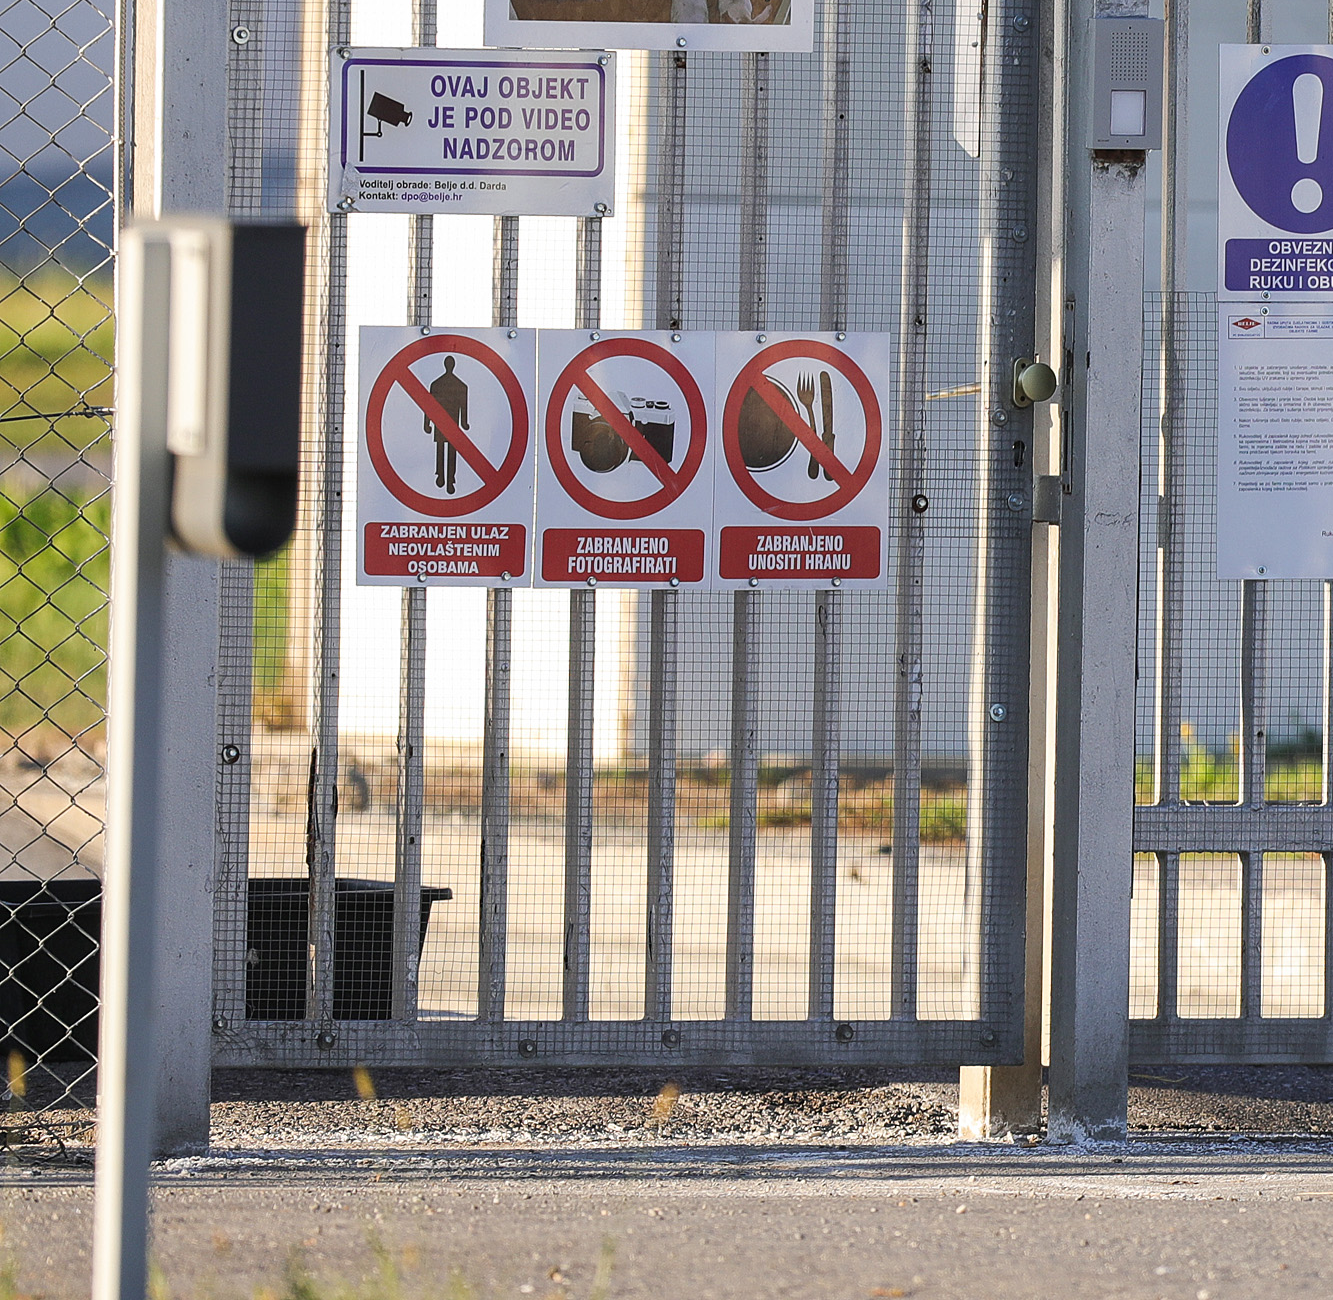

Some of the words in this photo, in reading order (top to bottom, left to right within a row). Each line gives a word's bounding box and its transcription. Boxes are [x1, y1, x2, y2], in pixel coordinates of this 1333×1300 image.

[430, 74, 488, 98] OVAJ
[498, 76, 588, 99] OBJEKT
[427, 106, 454, 128] JE
[465, 106, 512, 129] POD
[521, 108, 590, 130] VIDEO
[443, 137, 574, 161] NADZOROM
[359, 179, 393, 190] Voditelj
[396, 180, 431, 189] obrade:
[434, 180, 457, 191] Belje
[459, 181, 476, 189] d.d.
[479, 181, 506, 190] Darda
[358, 191, 398, 200] Kontakt:
[401, 192, 462, 202] dpo@belje.hr
[1250, 275, 1293, 288] RUKU
[1299, 275, 1302, 288] I
[380, 525, 466, 541] ZABRANJEN
[471, 526, 508, 538] ULAZ
[388, 540, 499, 556] NEOVLAŠTENIM
[576, 537, 668, 557] ZABRANJENO
[756, 534, 843, 551] ZABRANJENO
[408, 560, 478, 574] OSOBAMA
[568, 556, 676, 573] FOTOGRAFIRATI
[748, 553, 800, 570] UNOSITI
[805, 553, 850, 569] HRANU
